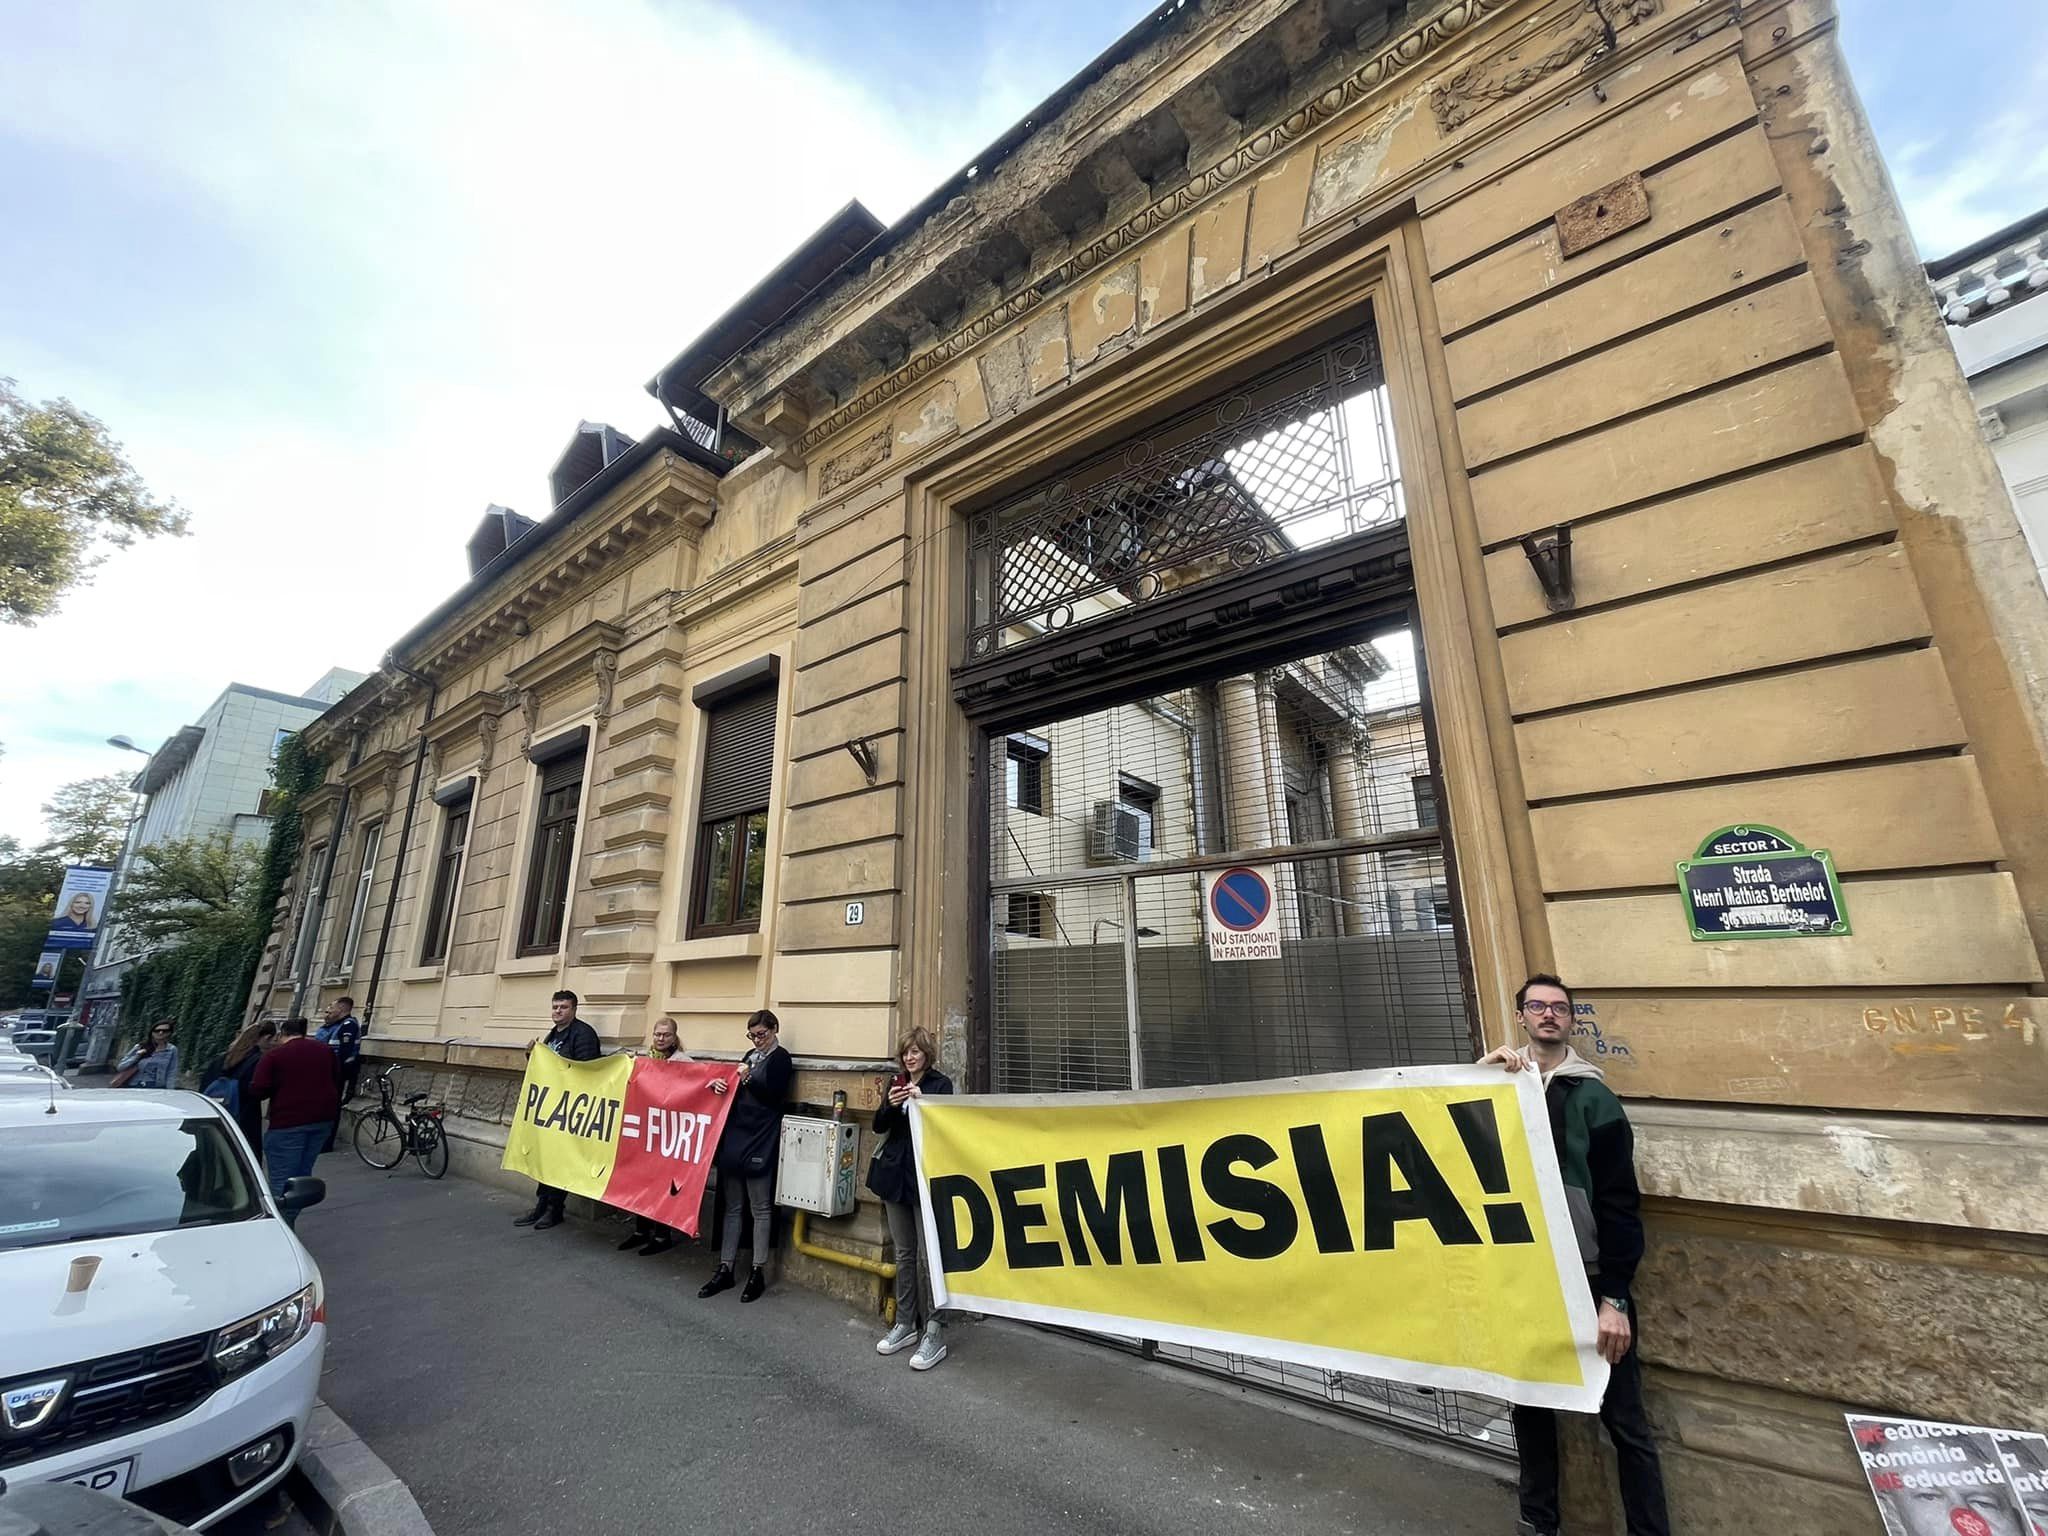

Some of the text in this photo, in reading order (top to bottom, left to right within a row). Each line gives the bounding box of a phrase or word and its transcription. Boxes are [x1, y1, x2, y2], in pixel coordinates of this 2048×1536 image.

[1714, 839, 1779, 854] SECTOR 1
[1732, 864, 1772, 884] Strada
[1692, 882, 1827, 907] Henri Mathias Berthelot
[849, 905, 859, 921] 29
[1211, 932, 1227, 945] NU
[1596, 1040, 1629, 1055] 8 m
[523, 1083, 620, 1143] PLAGIAT
[645, 1107, 712, 1165] FURT
[929, 1098, 1535, 1274] DEMISIA!
[11, 1389, 55, 1403] DACIA
[1860, 1442, 1967, 1470] România
